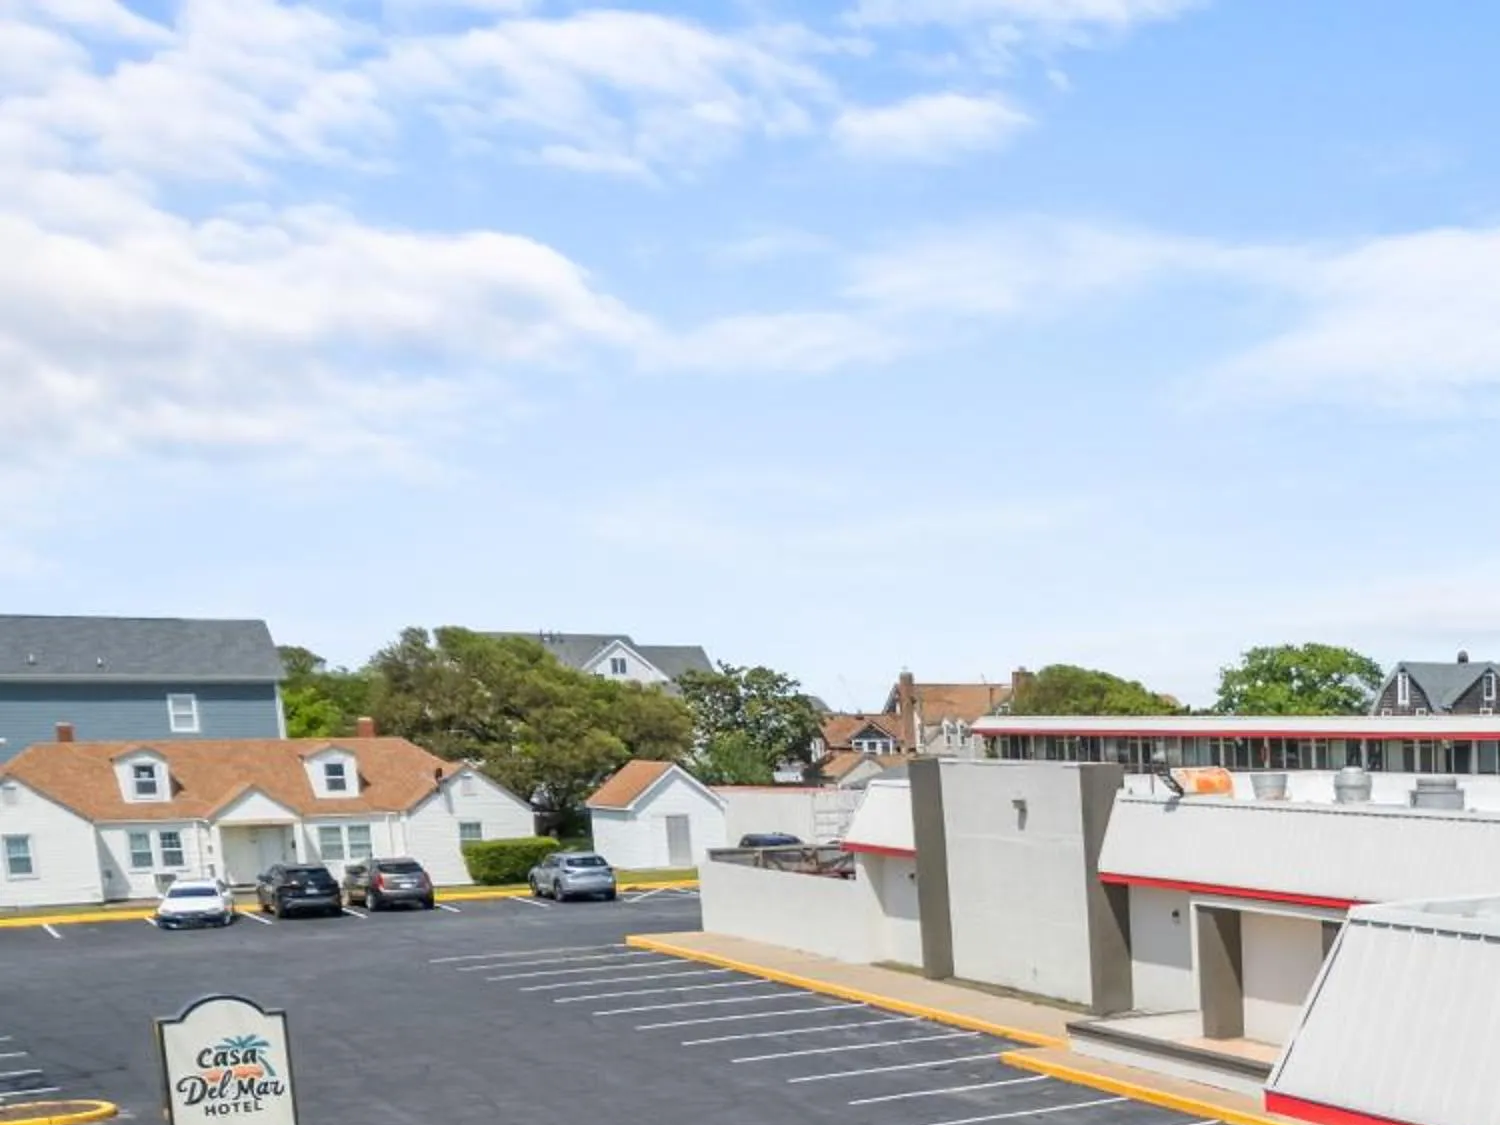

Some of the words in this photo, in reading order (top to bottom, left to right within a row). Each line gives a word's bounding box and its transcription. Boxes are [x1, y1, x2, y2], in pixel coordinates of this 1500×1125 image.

[196, 1048, 257, 1069] Casa
[176, 1069, 233, 1106] Del
[232, 1077, 285, 1101] Mar
[204, 1101, 264, 1116] HOTEL
